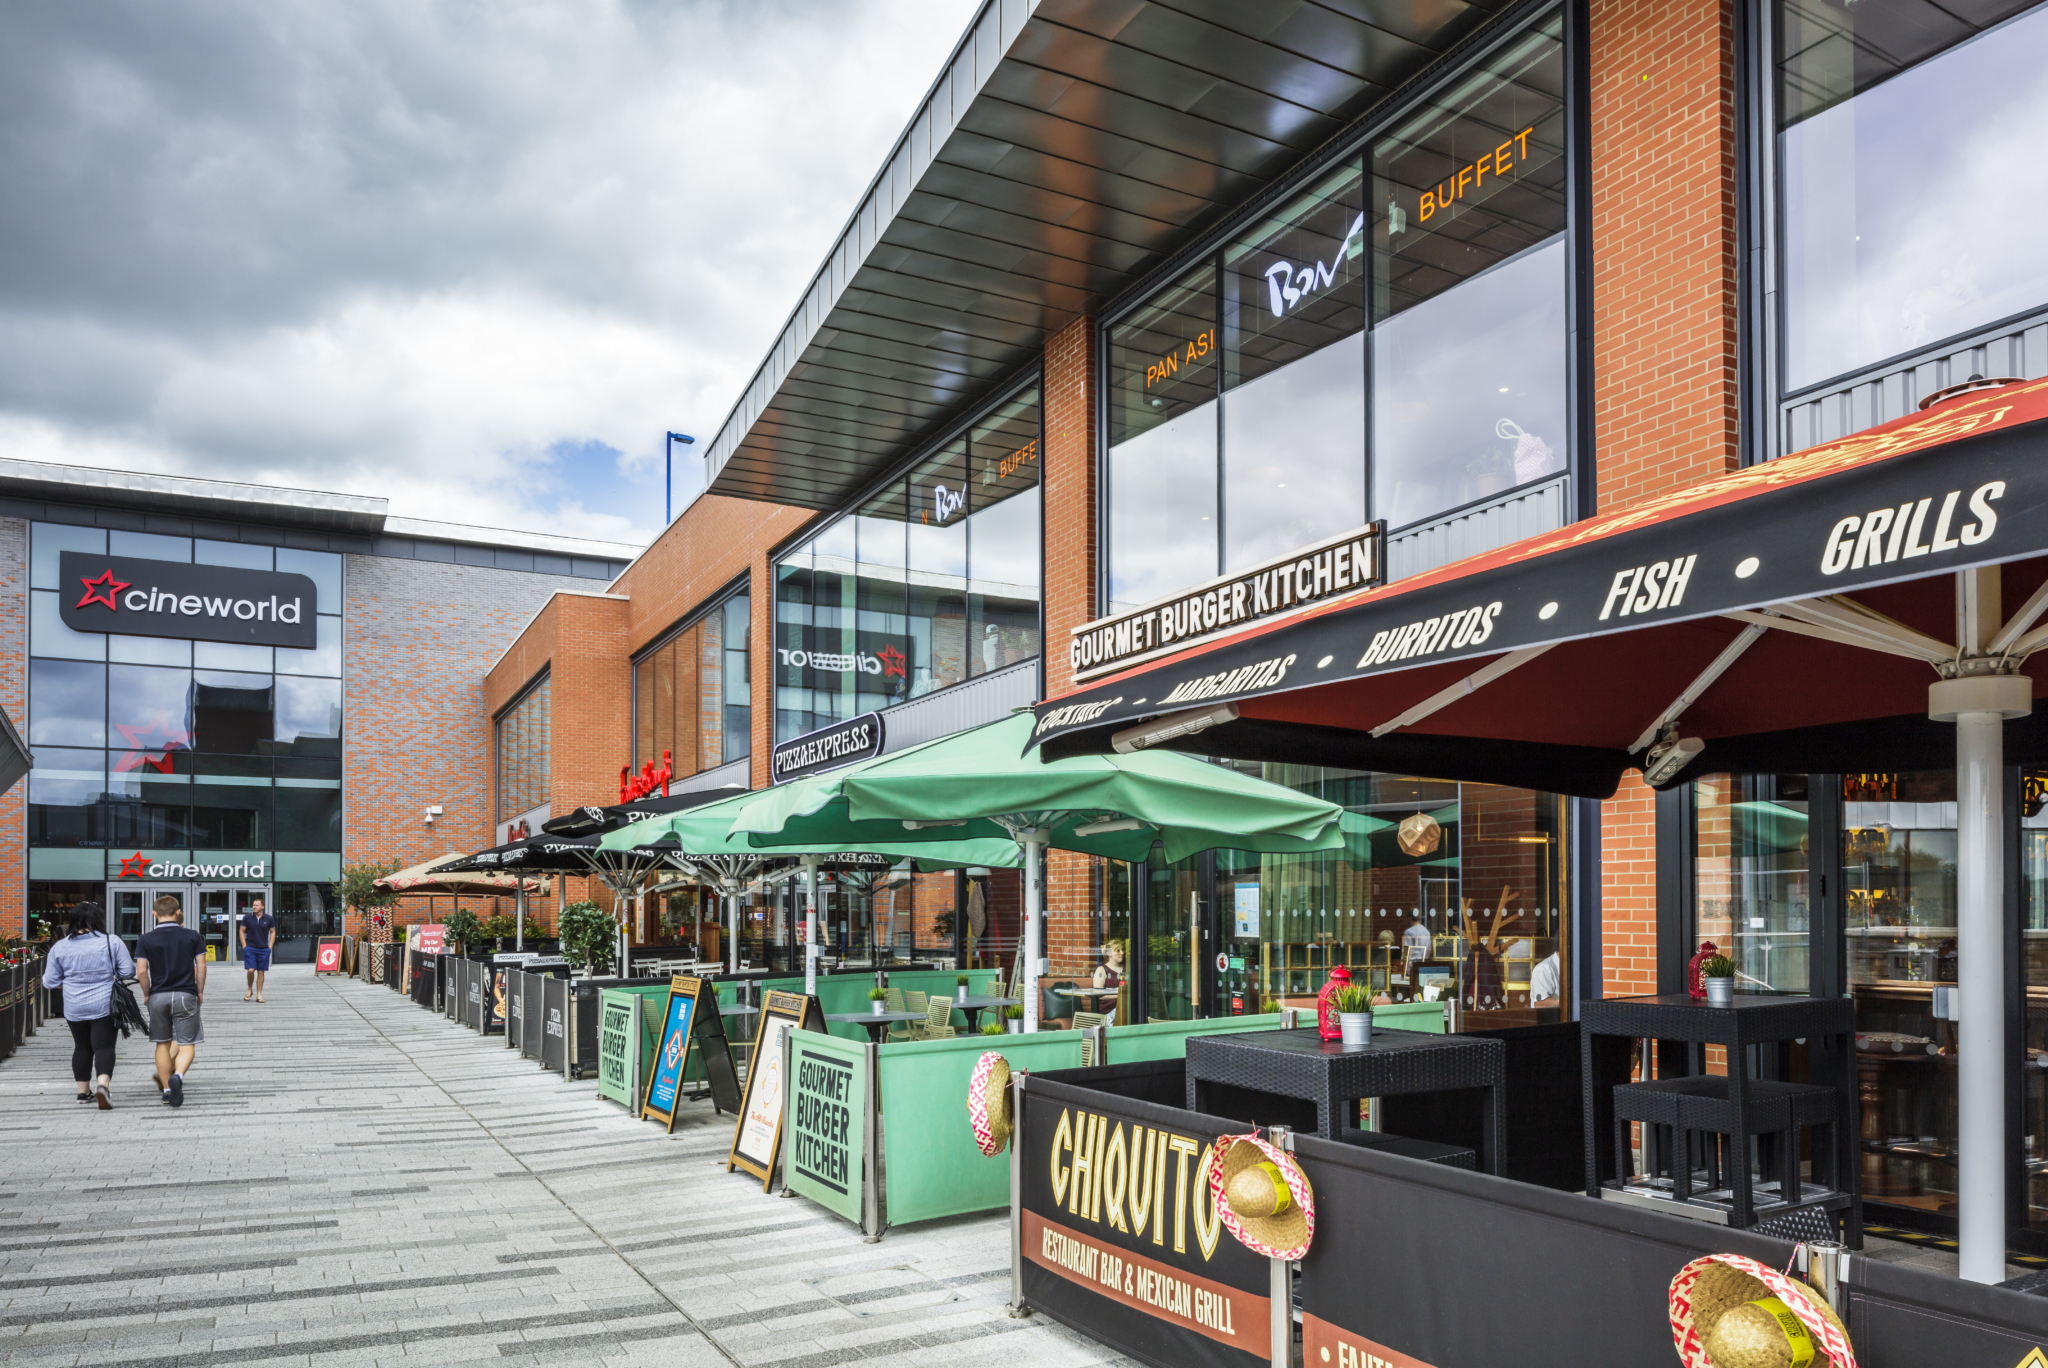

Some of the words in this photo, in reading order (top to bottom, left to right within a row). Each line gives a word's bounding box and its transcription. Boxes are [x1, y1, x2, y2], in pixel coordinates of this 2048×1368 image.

[1420, 127, 1533, 222] BUFFET
[1147, 352, 1178, 388] PAN
[1185, 329, 1217, 366] ASI
[1000, 439, 1039, 478] BUFFE
[124, 586, 301, 624] cineworld
[1070, 612, 1158, 669] GOURMET
[1161, 581, 1250, 642] BURGER
[1254, 537, 1378, 613] KITCHEN
[1157, 654, 1297, 705] MARGARITAS
[1356, 601, 1502, 668] BURRITOS
[1599, 554, 1697, 620] FISH
[1820, 480, 2005, 575] GRILLS
[775, 724, 870, 775] PIZZAEXPRESS
[149, 860, 265, 878] cineworld
[602, 1029, 627, 1060] BURGER
[604, 1009, 630, 1033] GOURMET
[799, 1060, 852, 1104] GOURMET
[796, 1091, 850, 1146] BURGER
[795, 1130, 849, 1185] KITCHEN
[1051, 1107, 1222, 1262] CHIQUITO
[1042, 1226, 1099, 1282] RESTAURANT
[1100, 1251, 1122, 1292] BAR
[1124, 1262, 1134, 1297] &
[1136, 1265, 1192, 1320] MEXICAN
[1194, 1287, 1236, 1336] GRILL
